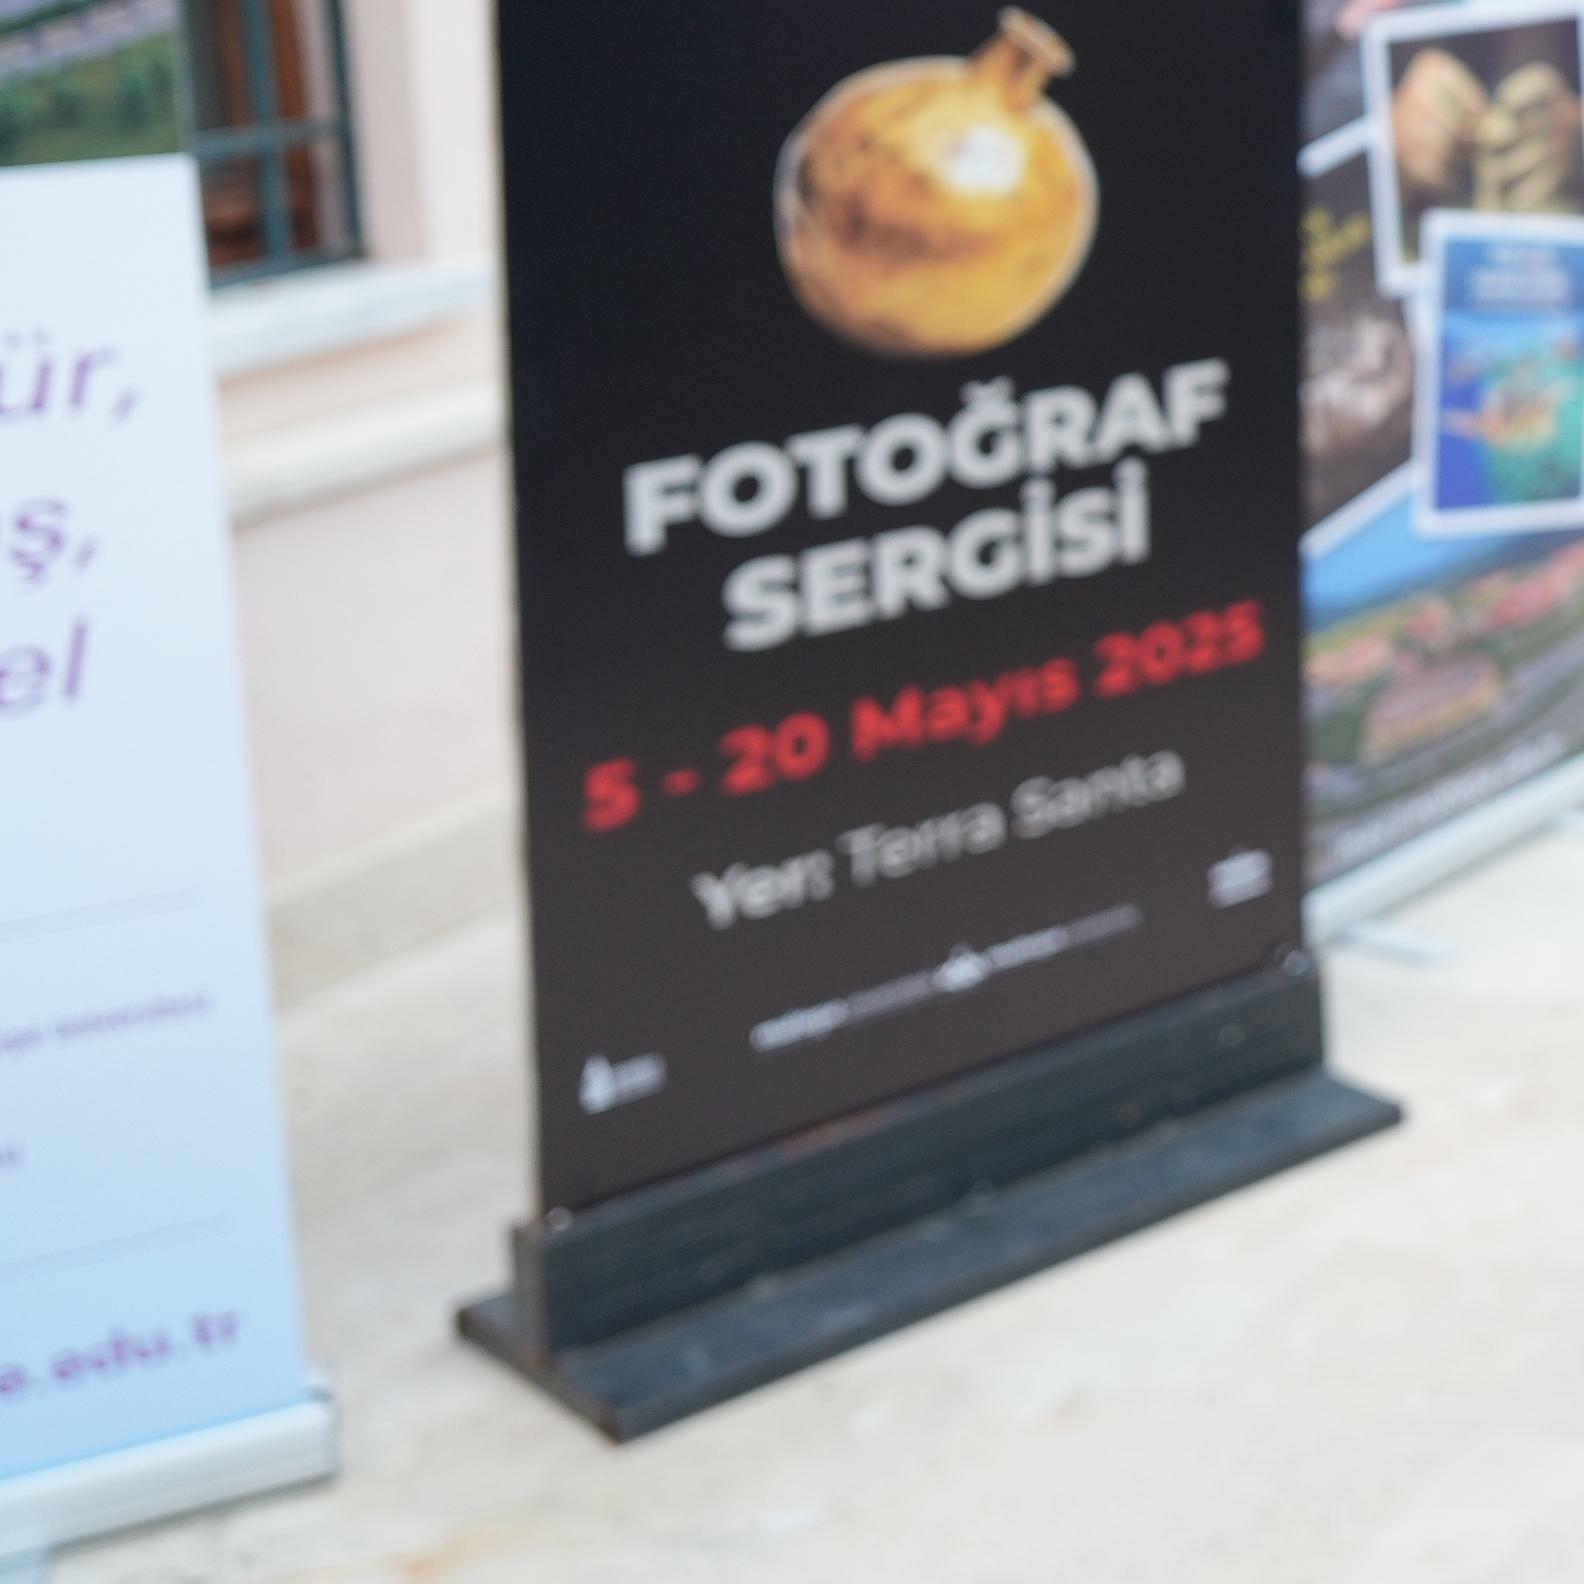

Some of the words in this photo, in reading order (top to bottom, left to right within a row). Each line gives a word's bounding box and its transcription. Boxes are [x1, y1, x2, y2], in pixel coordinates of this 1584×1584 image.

[623, 358, 1229, 556] FOTOĞRAF
[722, 456, 1151, 652] SERGİSİ
[581, 759, 641, 832] 5
[663, 766, 700, 798] -
[720, 711, 830, 795] 20
[851, 657, 1079, 761] Mayıs
[1093, 599, 1267, 699] 2025
[692, 848, 834, 928] Yer:
[837, 802, 1005, 887] Terra
[1010, 749, 1184, 839] Santa
